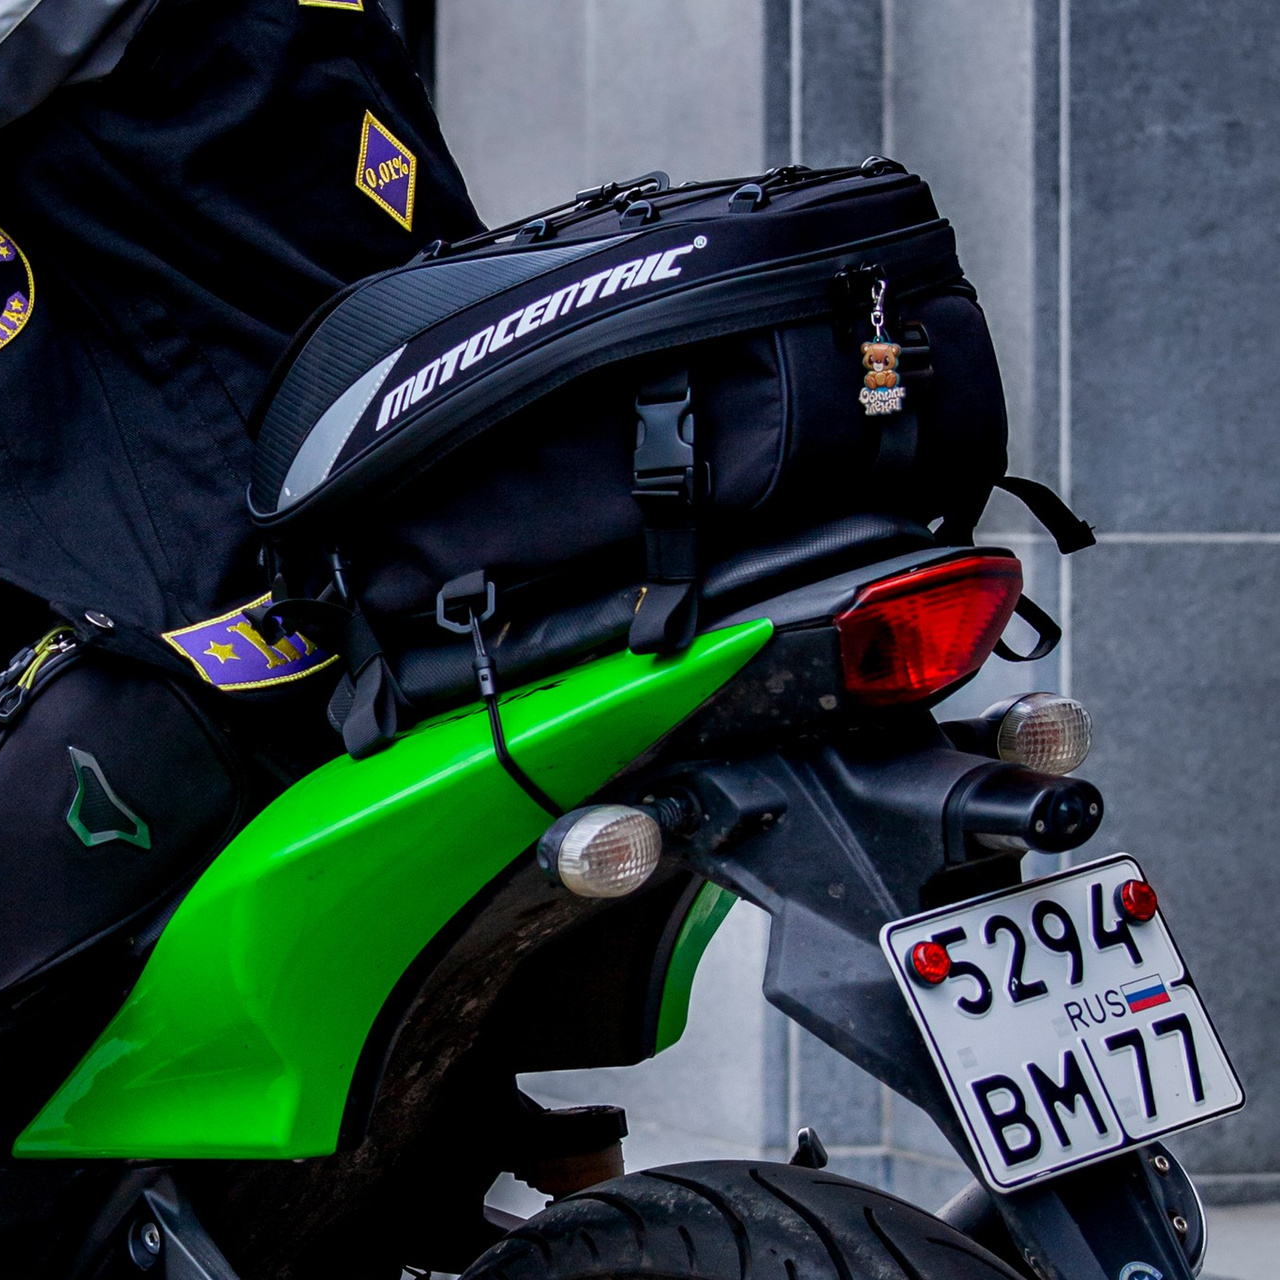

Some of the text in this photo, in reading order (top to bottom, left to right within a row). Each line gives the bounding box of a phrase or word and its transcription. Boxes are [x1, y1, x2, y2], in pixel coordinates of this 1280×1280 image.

[365, 155, 409, 190] 0,01%
[931, 882, 1144, 1017] 5294
[1063, 989, 1127, 1032] RUS
[1103, 1012, 1206, 1119] 77
